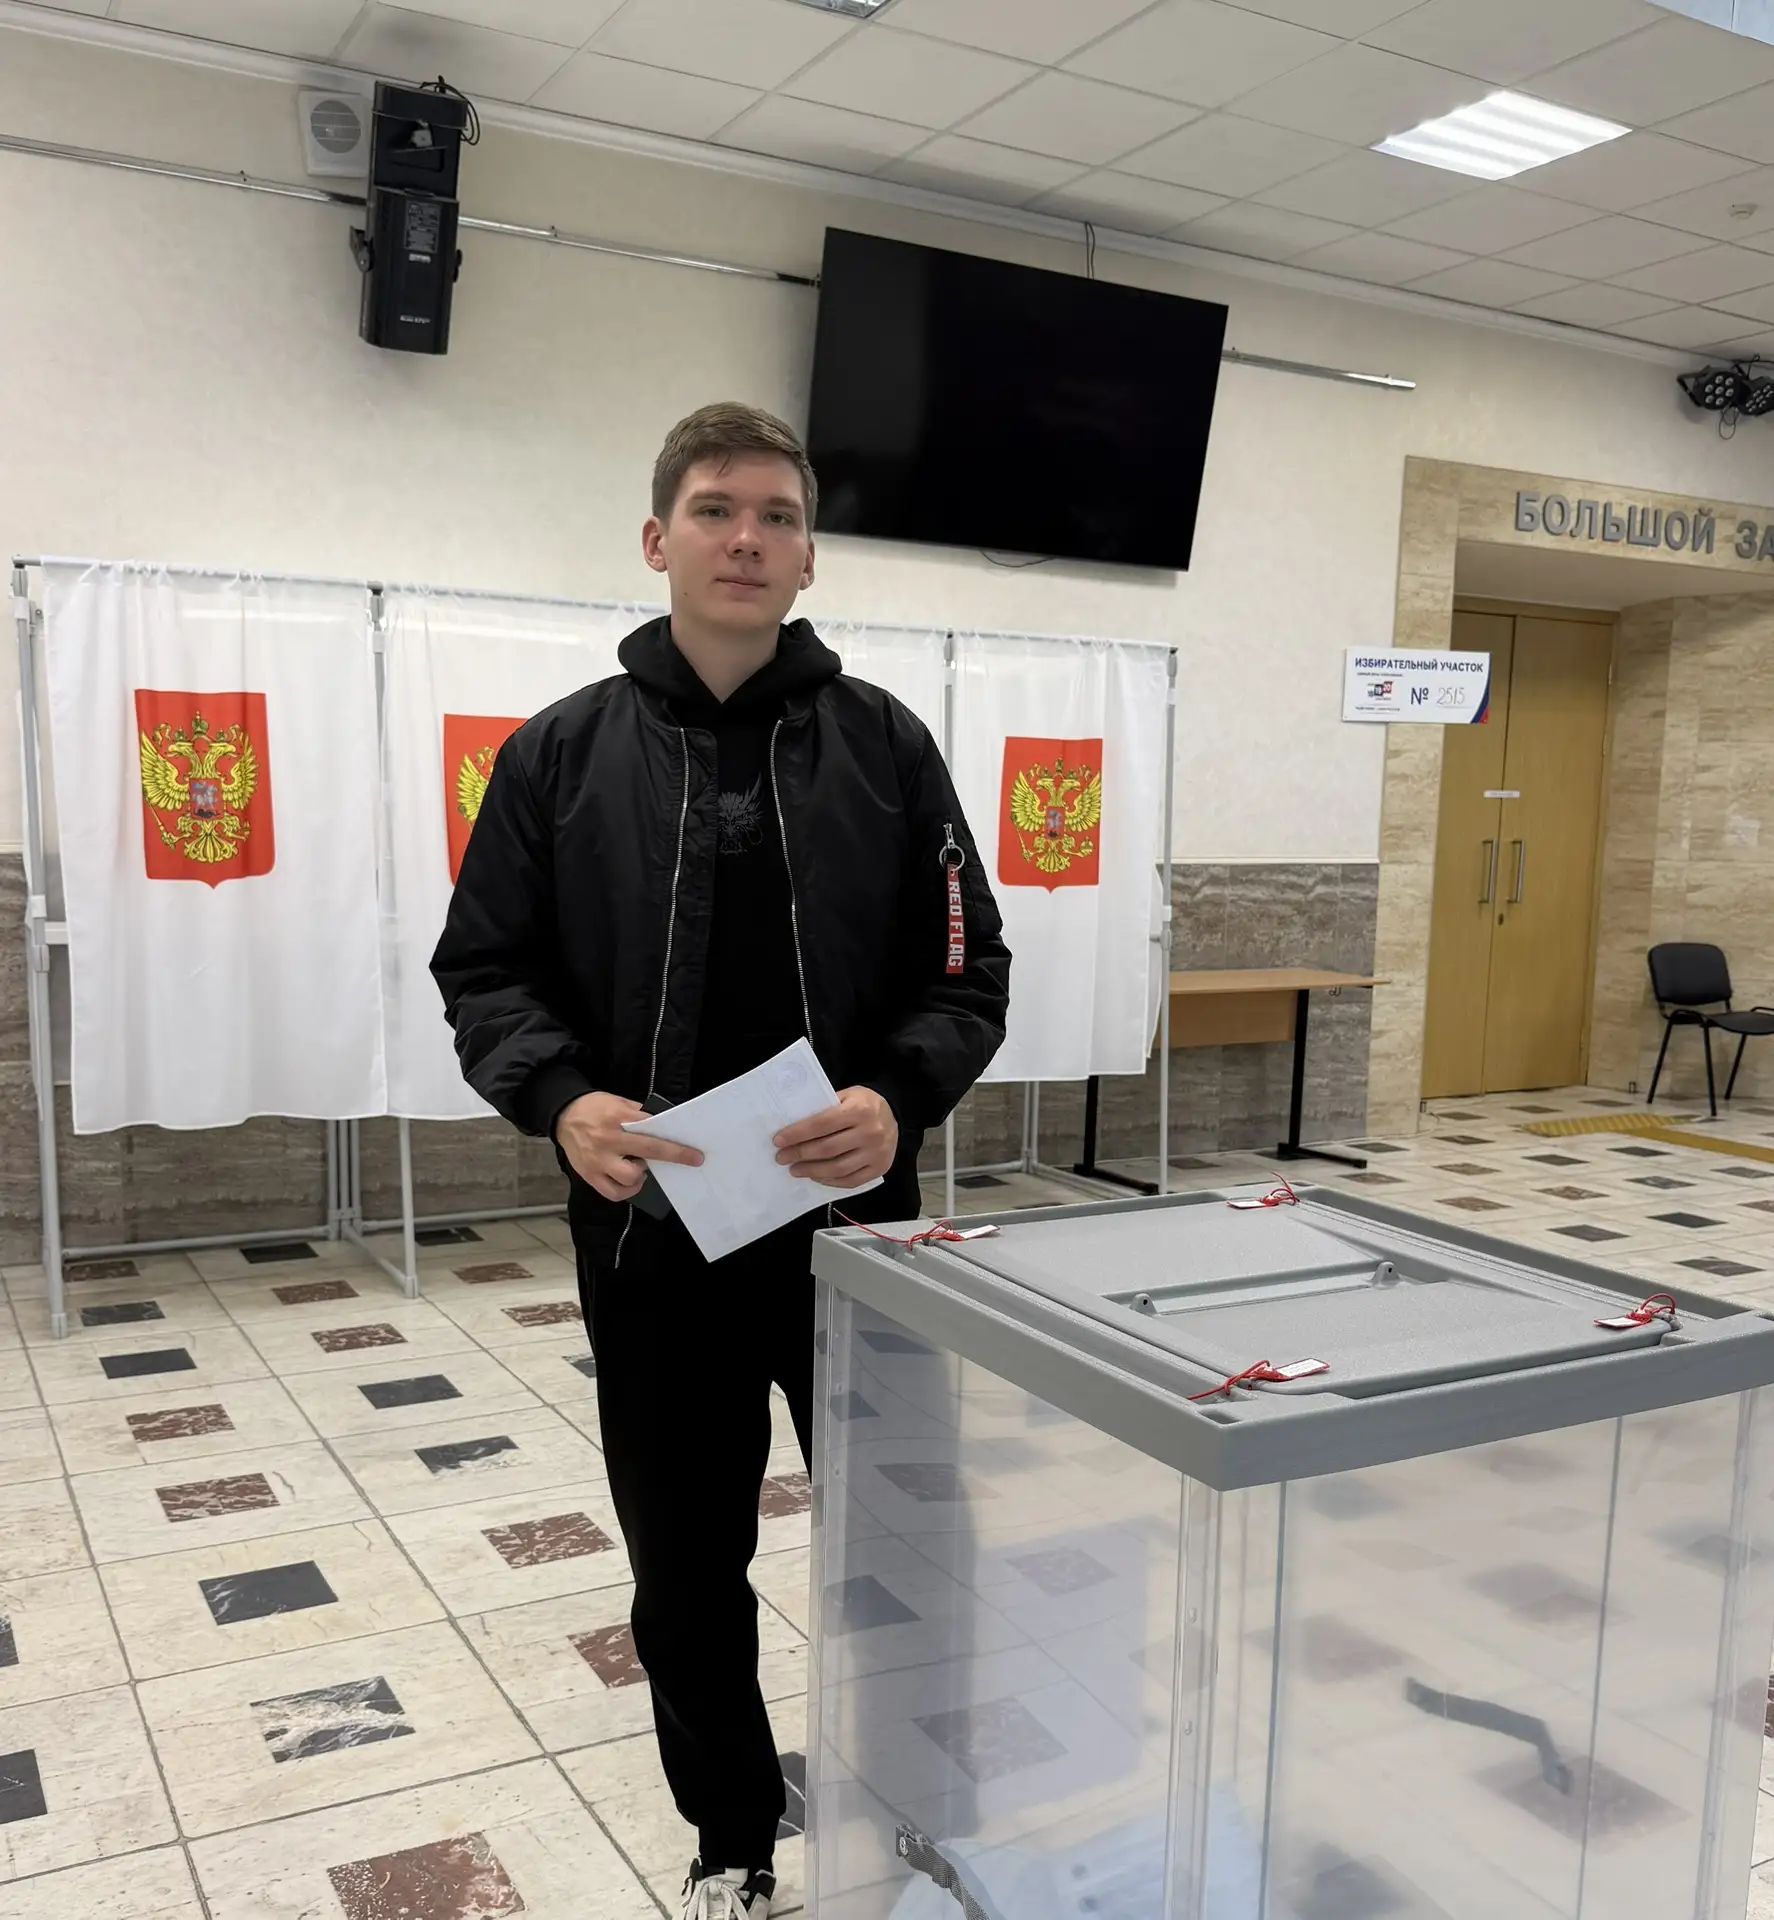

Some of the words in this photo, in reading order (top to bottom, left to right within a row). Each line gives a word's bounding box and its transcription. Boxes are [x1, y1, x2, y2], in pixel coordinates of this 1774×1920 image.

[1515, 491, 1716, 554] БОЛЬШОЙ
[1355, 657, 1438, 670] ИЗБИРАТЕЛЬНЫЙ
[1440, 661, 1484, 673] УЧАСТОК
[1410, 687, 1430, 706] №
[948, 881, 962, 916] RED
[948, 921, 964, 966] FLAG
